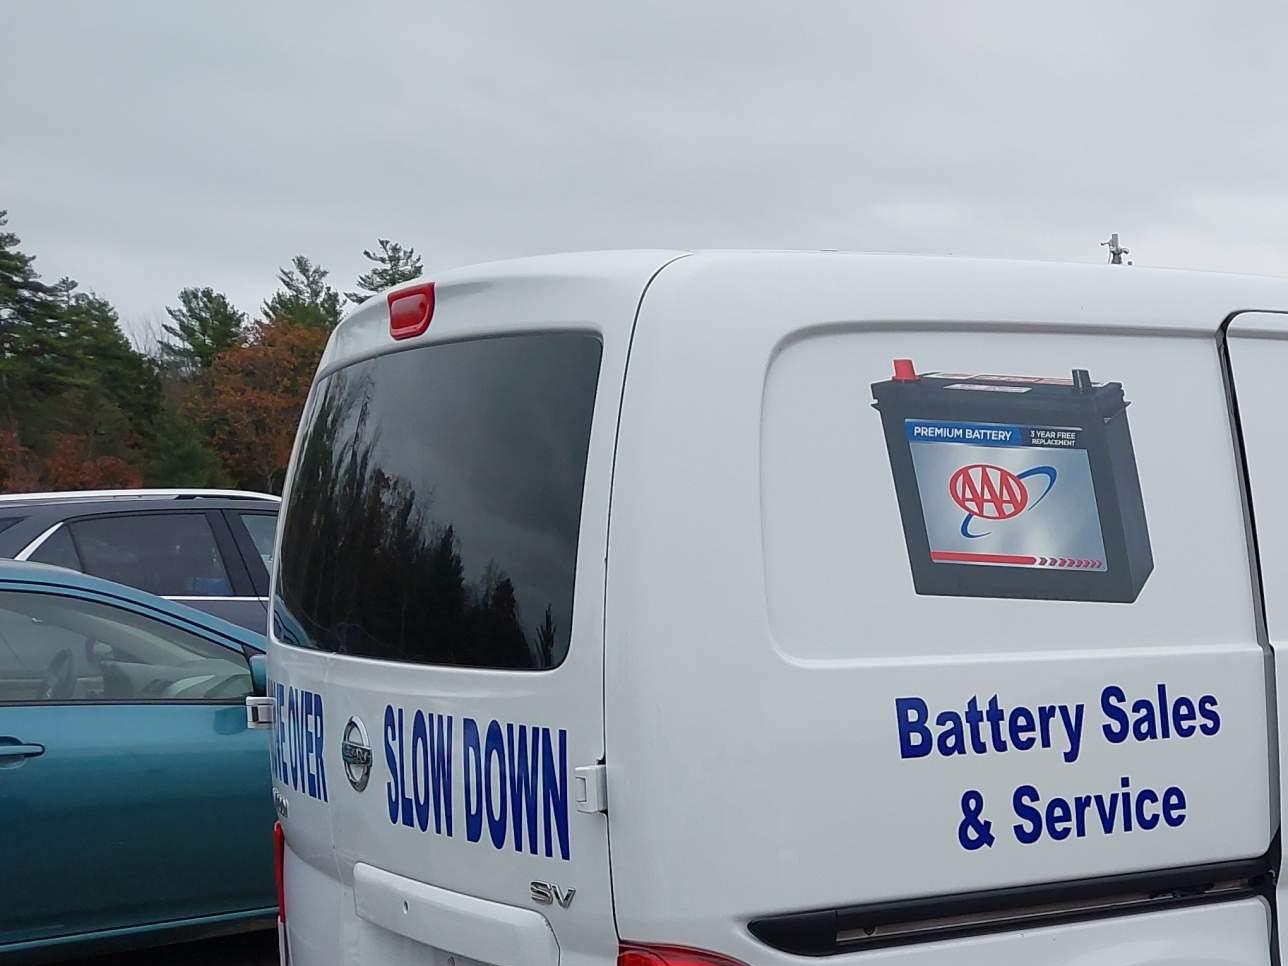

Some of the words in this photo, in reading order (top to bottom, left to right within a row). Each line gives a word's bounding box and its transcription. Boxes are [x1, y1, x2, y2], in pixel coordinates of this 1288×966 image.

[913, 426, 963, 440] PREMIUM
[965, 429, 1012, 441] BATTERY
[1031, 438, 1076, 446] REPLACEMENT
[1036, 430, 1056, 439] YEAR
[1057, 432, 1076, 440] FREE
[960, 467, 1020, 516] AAA
[288, 686, 329, 803] OVER
[895, 693, 1085, 763] Battery
[1100, 683, 1221, 744] Sales
[384, 704, 453, 837] SLOW
[463, 717, 570, 860] DOWN
[958, 789, 995, 850] &
[1012, 776, 1187, 845] Service
[530, 880, 577, 909] SV
